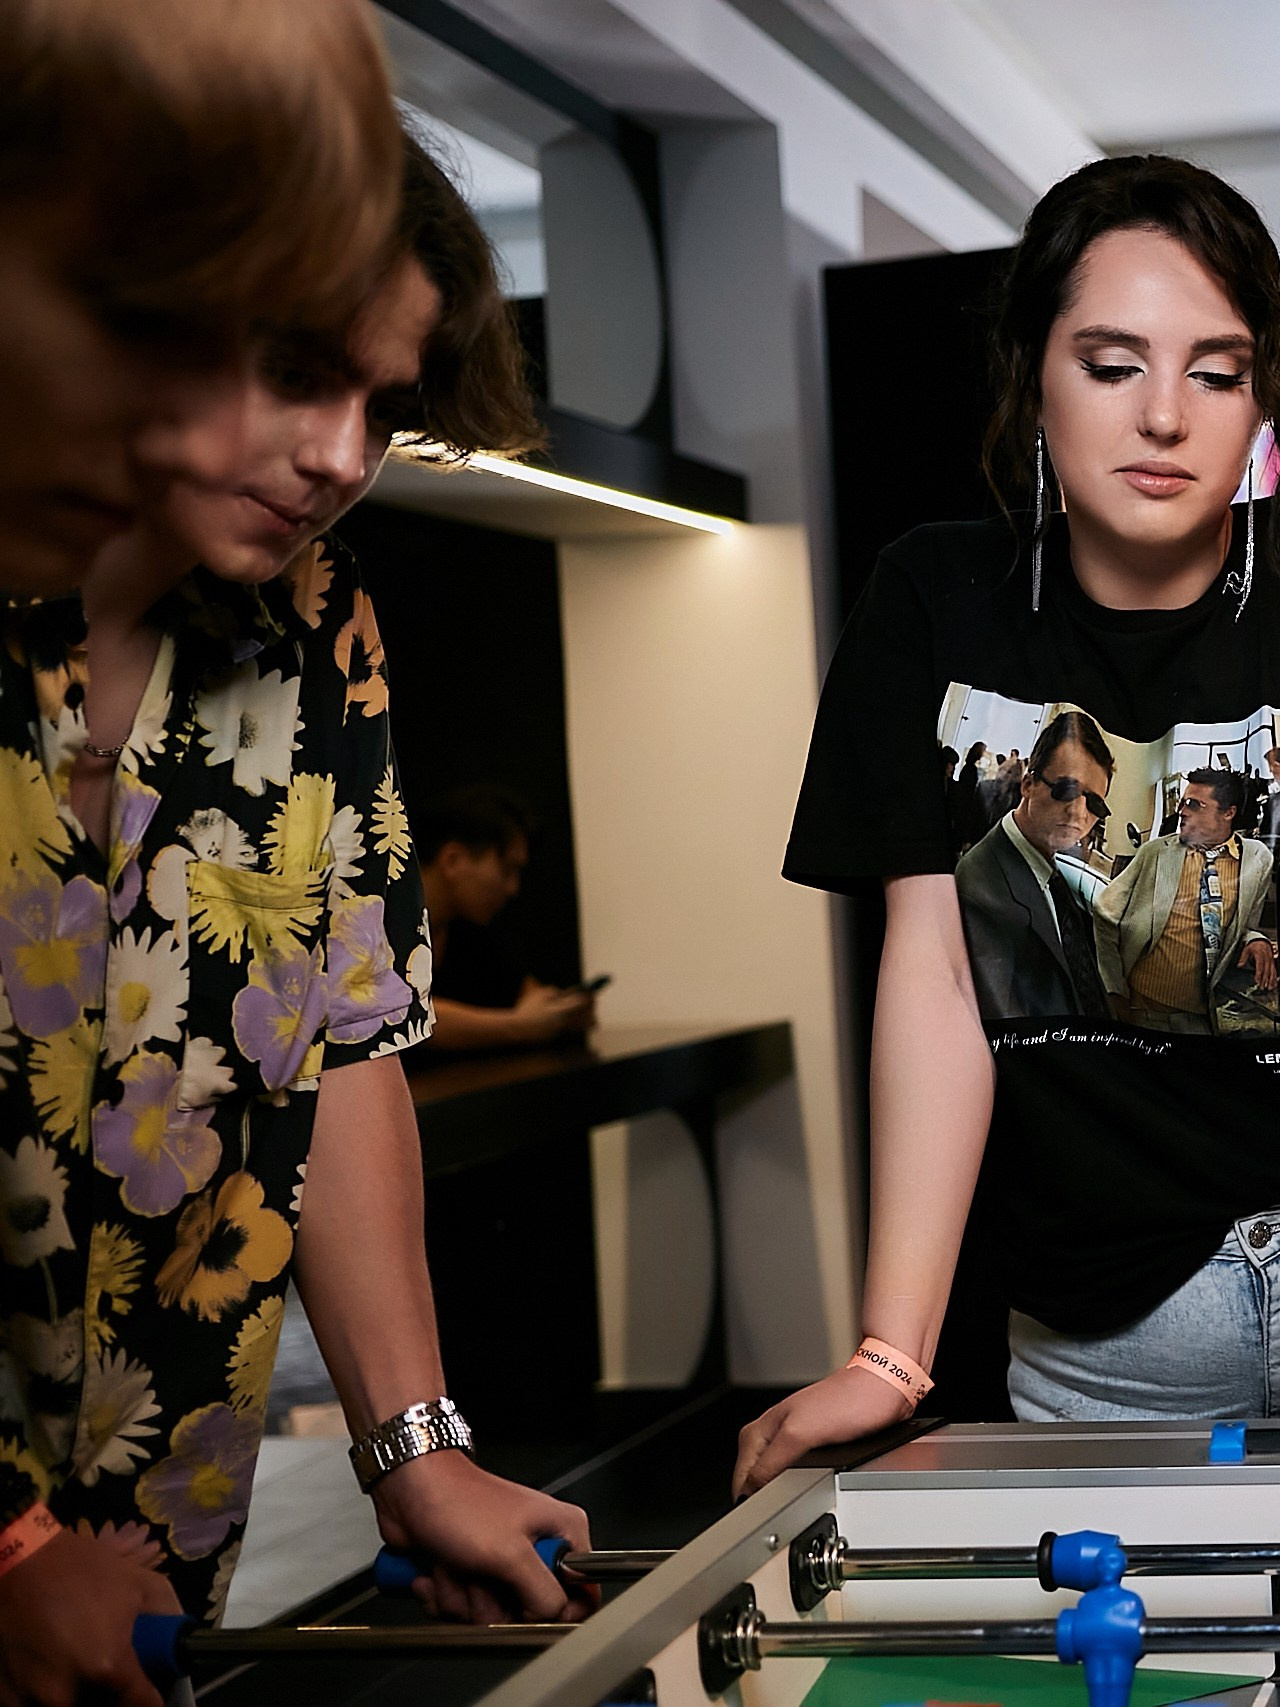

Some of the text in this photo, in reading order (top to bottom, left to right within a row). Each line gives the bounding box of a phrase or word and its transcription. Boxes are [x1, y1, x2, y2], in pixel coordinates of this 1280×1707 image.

[1003, 1032, 1019, 1049] life
[1022, 1029, 1048, 1045] and
[1052, 1027, 1069, 1041] I
[888, 1363, 913, 1386] 2024
